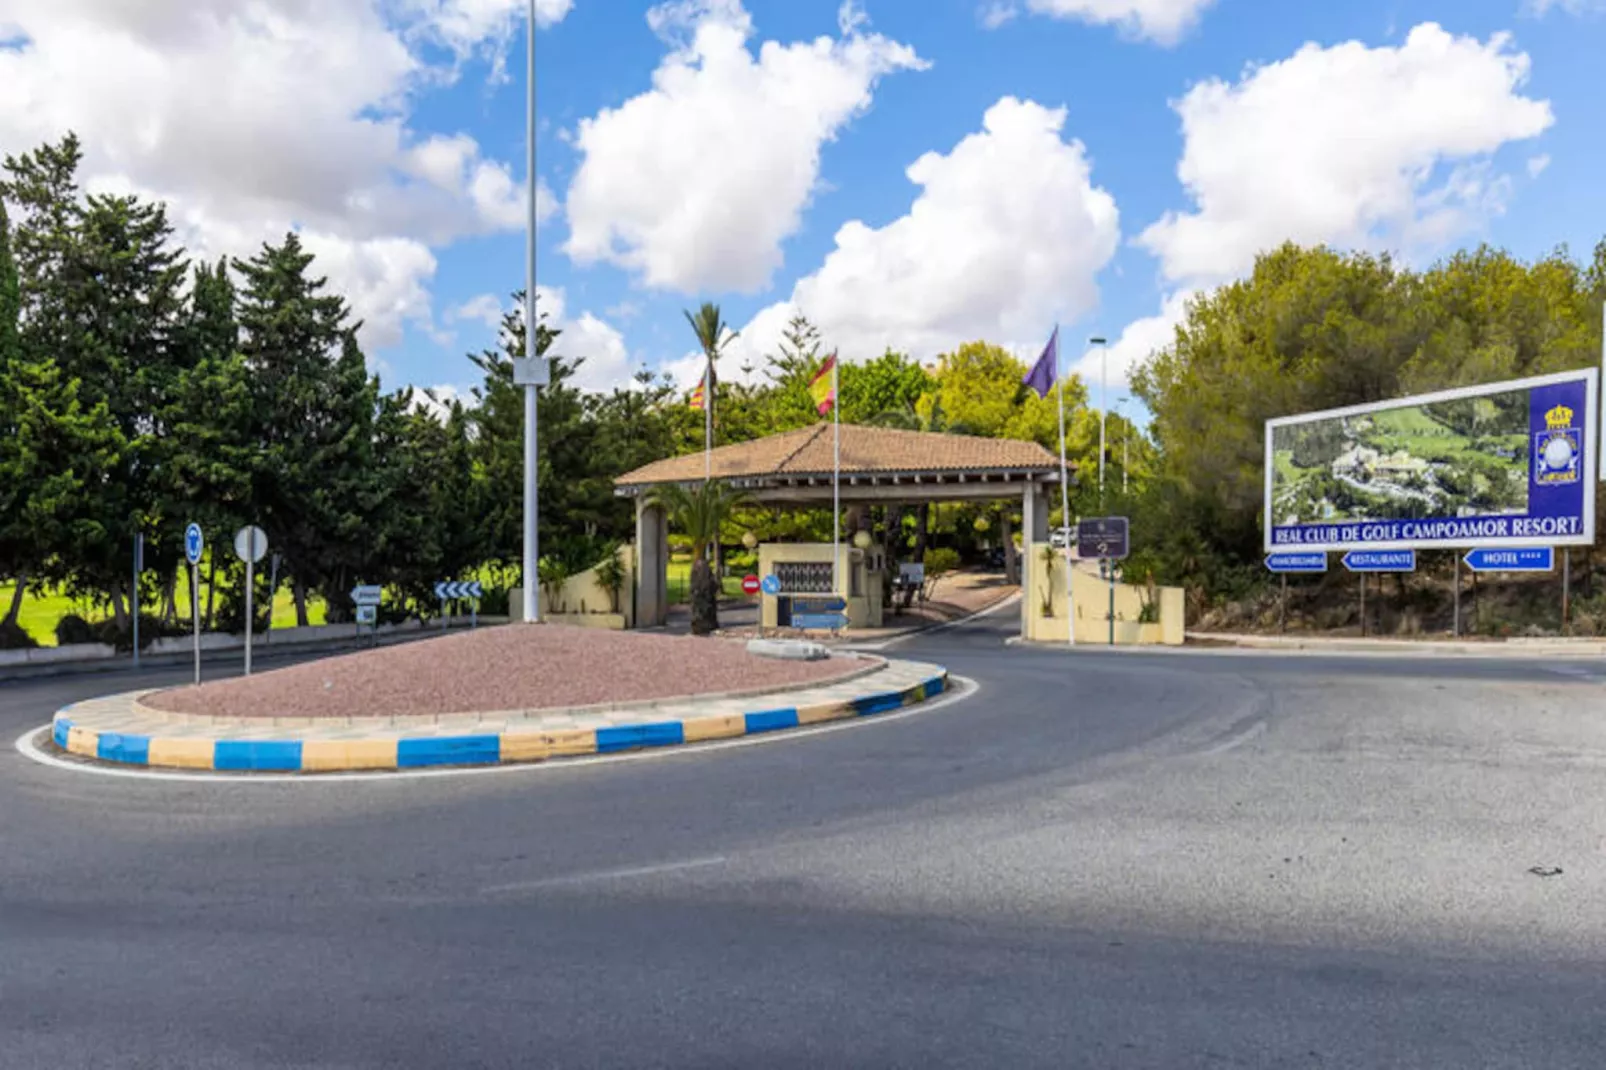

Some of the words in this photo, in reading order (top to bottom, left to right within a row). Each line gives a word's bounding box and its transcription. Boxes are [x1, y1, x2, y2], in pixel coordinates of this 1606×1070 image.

[1276, 528, 1302, 542] REAL
[1304, 527, 1338, 542] CLUB
[1342, 526, 1360, 541] DE
[1362, 524, 1400, 540] GOLF
[1402, 518, 1507, 538] CAMPOAMOR
[1513, 516, 1579, 535] RESORT
[1482, 552, 1518, 564] HOTEL
